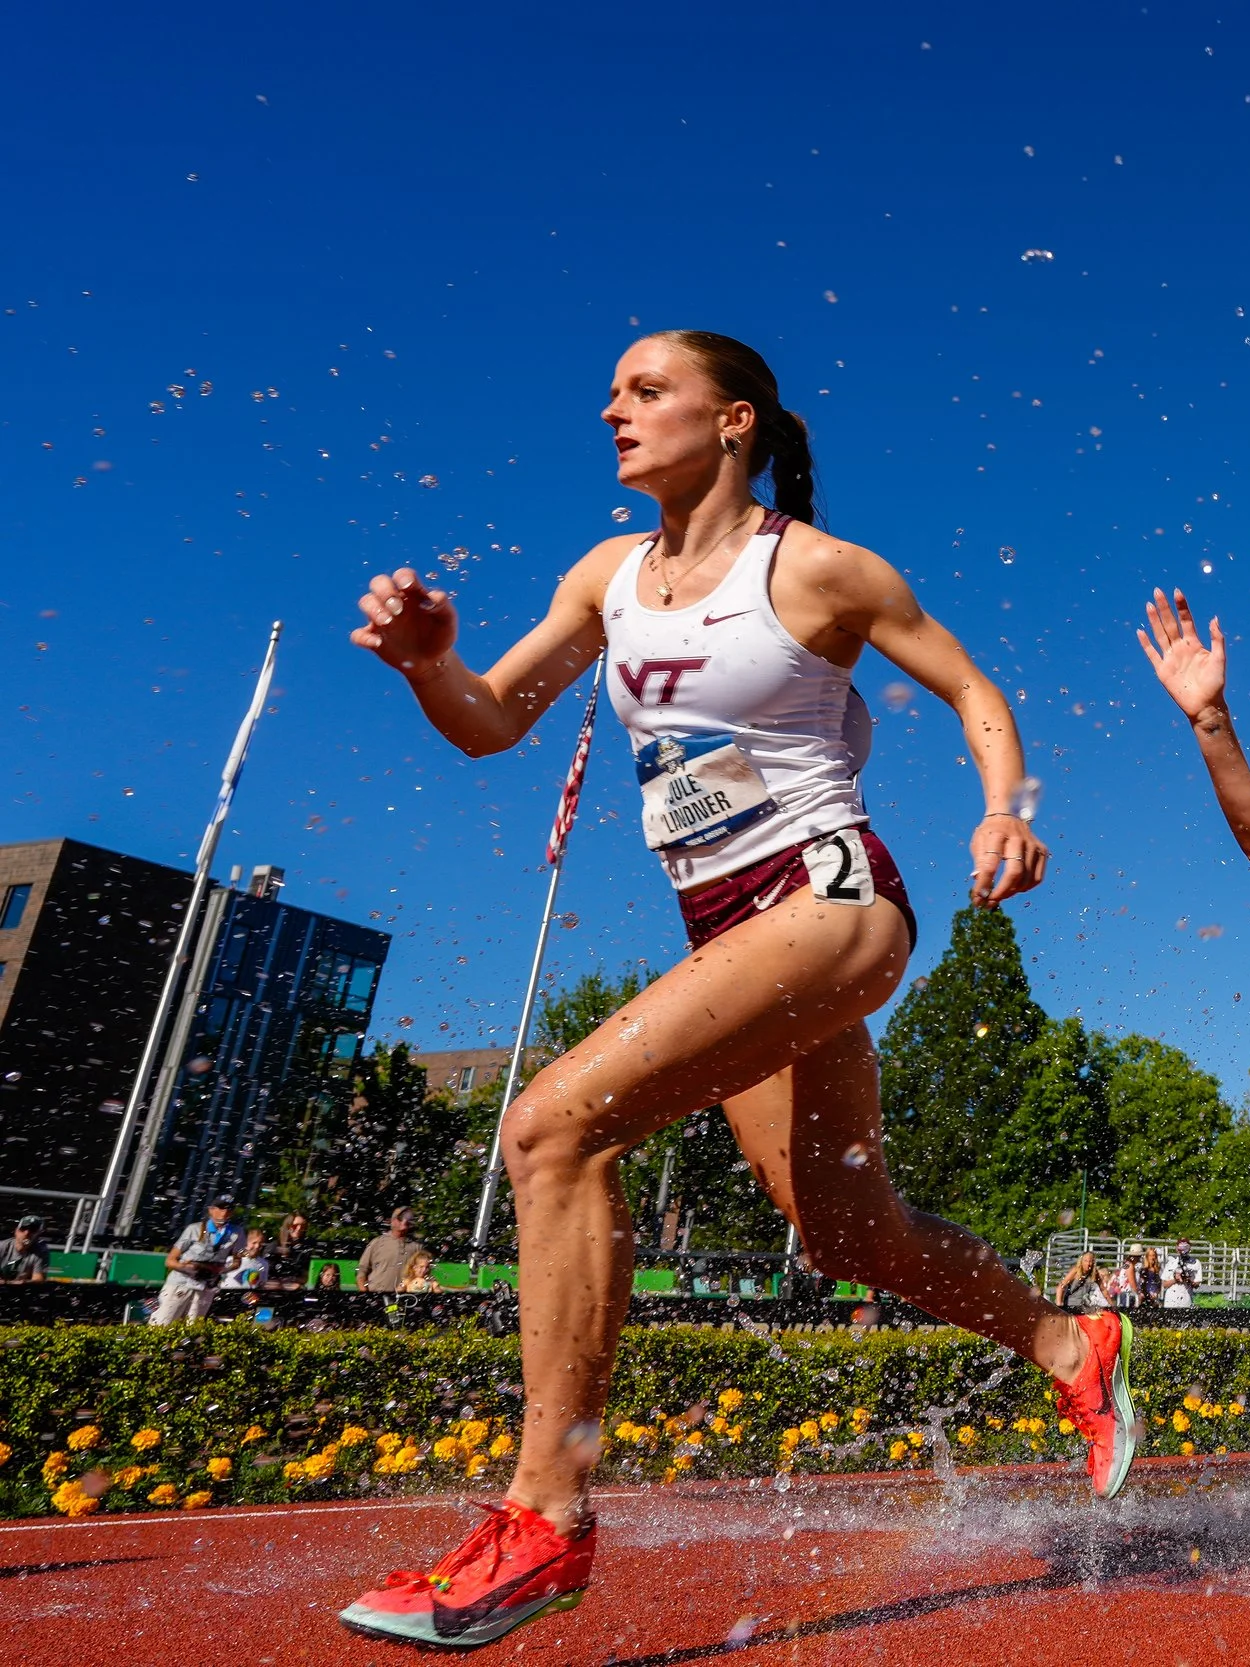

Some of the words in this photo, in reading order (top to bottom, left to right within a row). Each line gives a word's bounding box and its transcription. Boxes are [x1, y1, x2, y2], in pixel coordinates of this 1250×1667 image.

[615, 656, 712, 707] VT
[661, 790, 732, 834] LINDNER
[665, 773, 703, 804] JULE
[815, 835, 860, 900] 2
